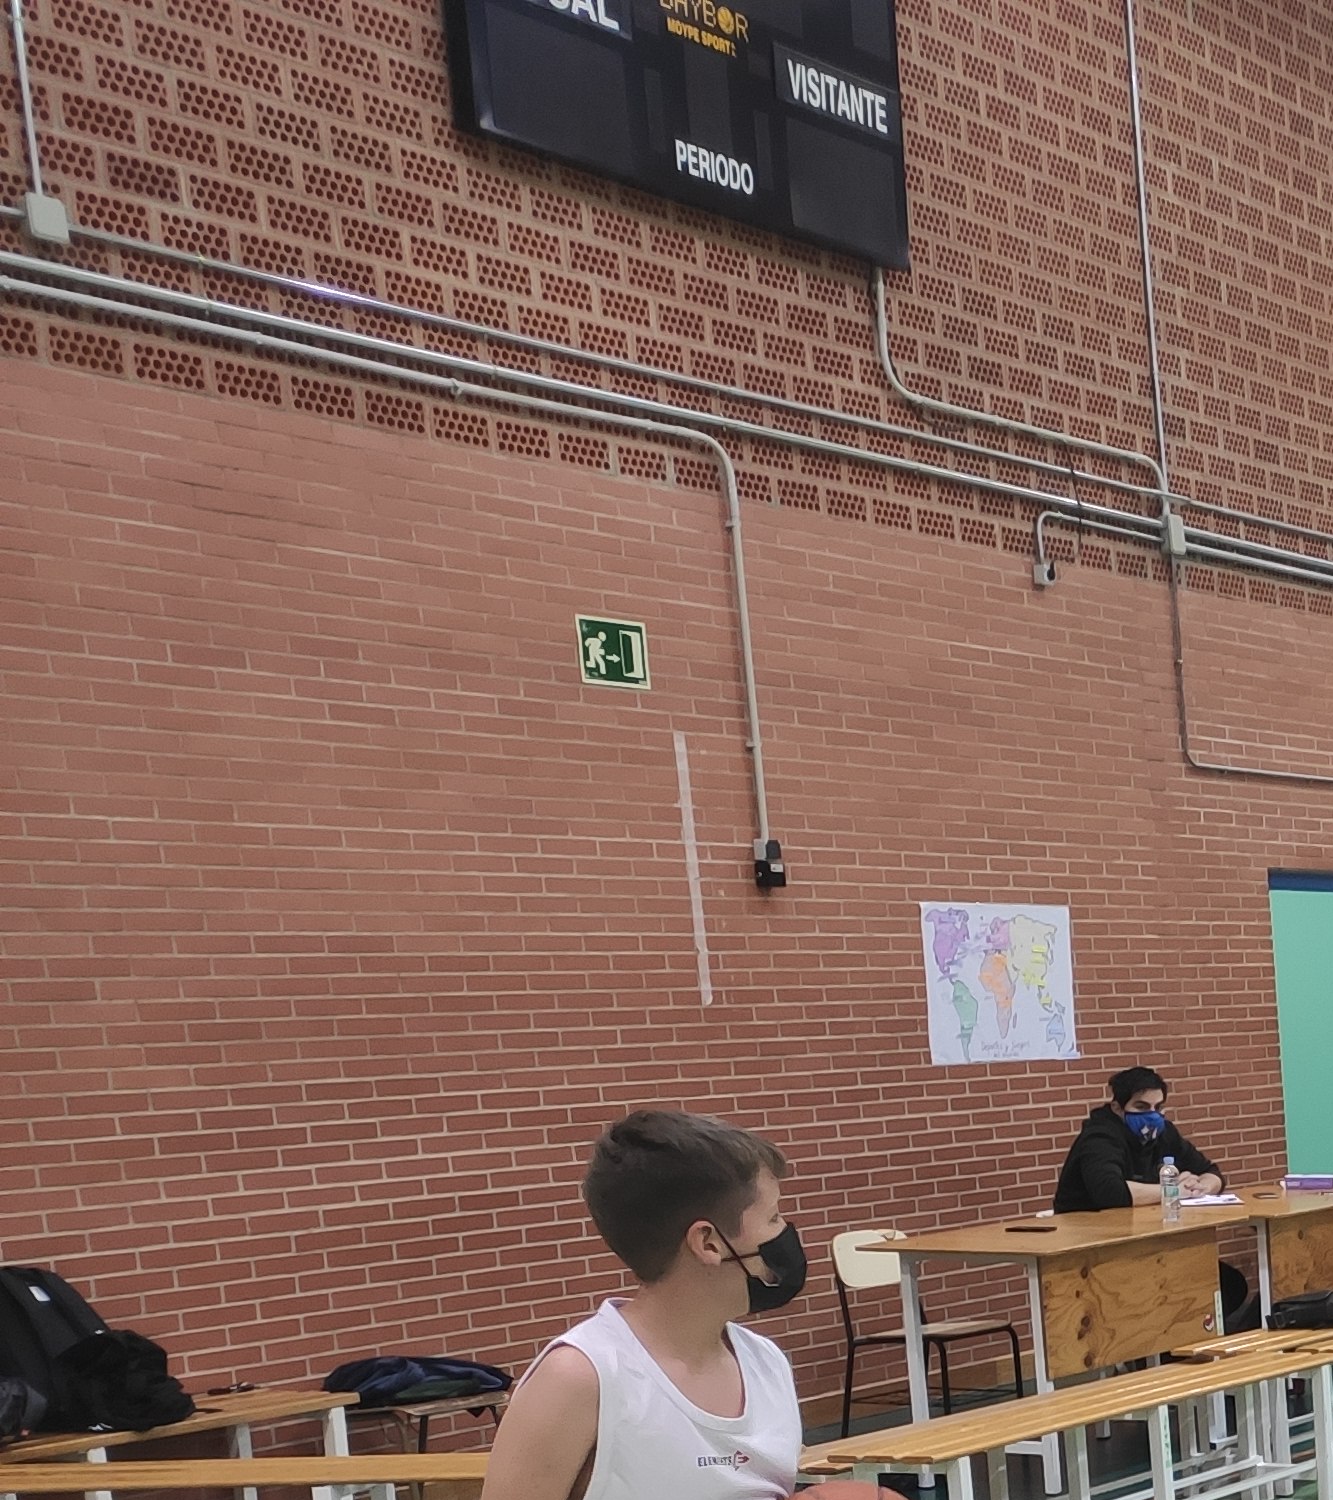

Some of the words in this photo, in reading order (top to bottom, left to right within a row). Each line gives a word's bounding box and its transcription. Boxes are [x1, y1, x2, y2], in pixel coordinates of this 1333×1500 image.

[701, 31, 731, 55] SPORT
[787, 59, 888, 134] VISITANTE
[675, 139, 753, 195] PERIODO
